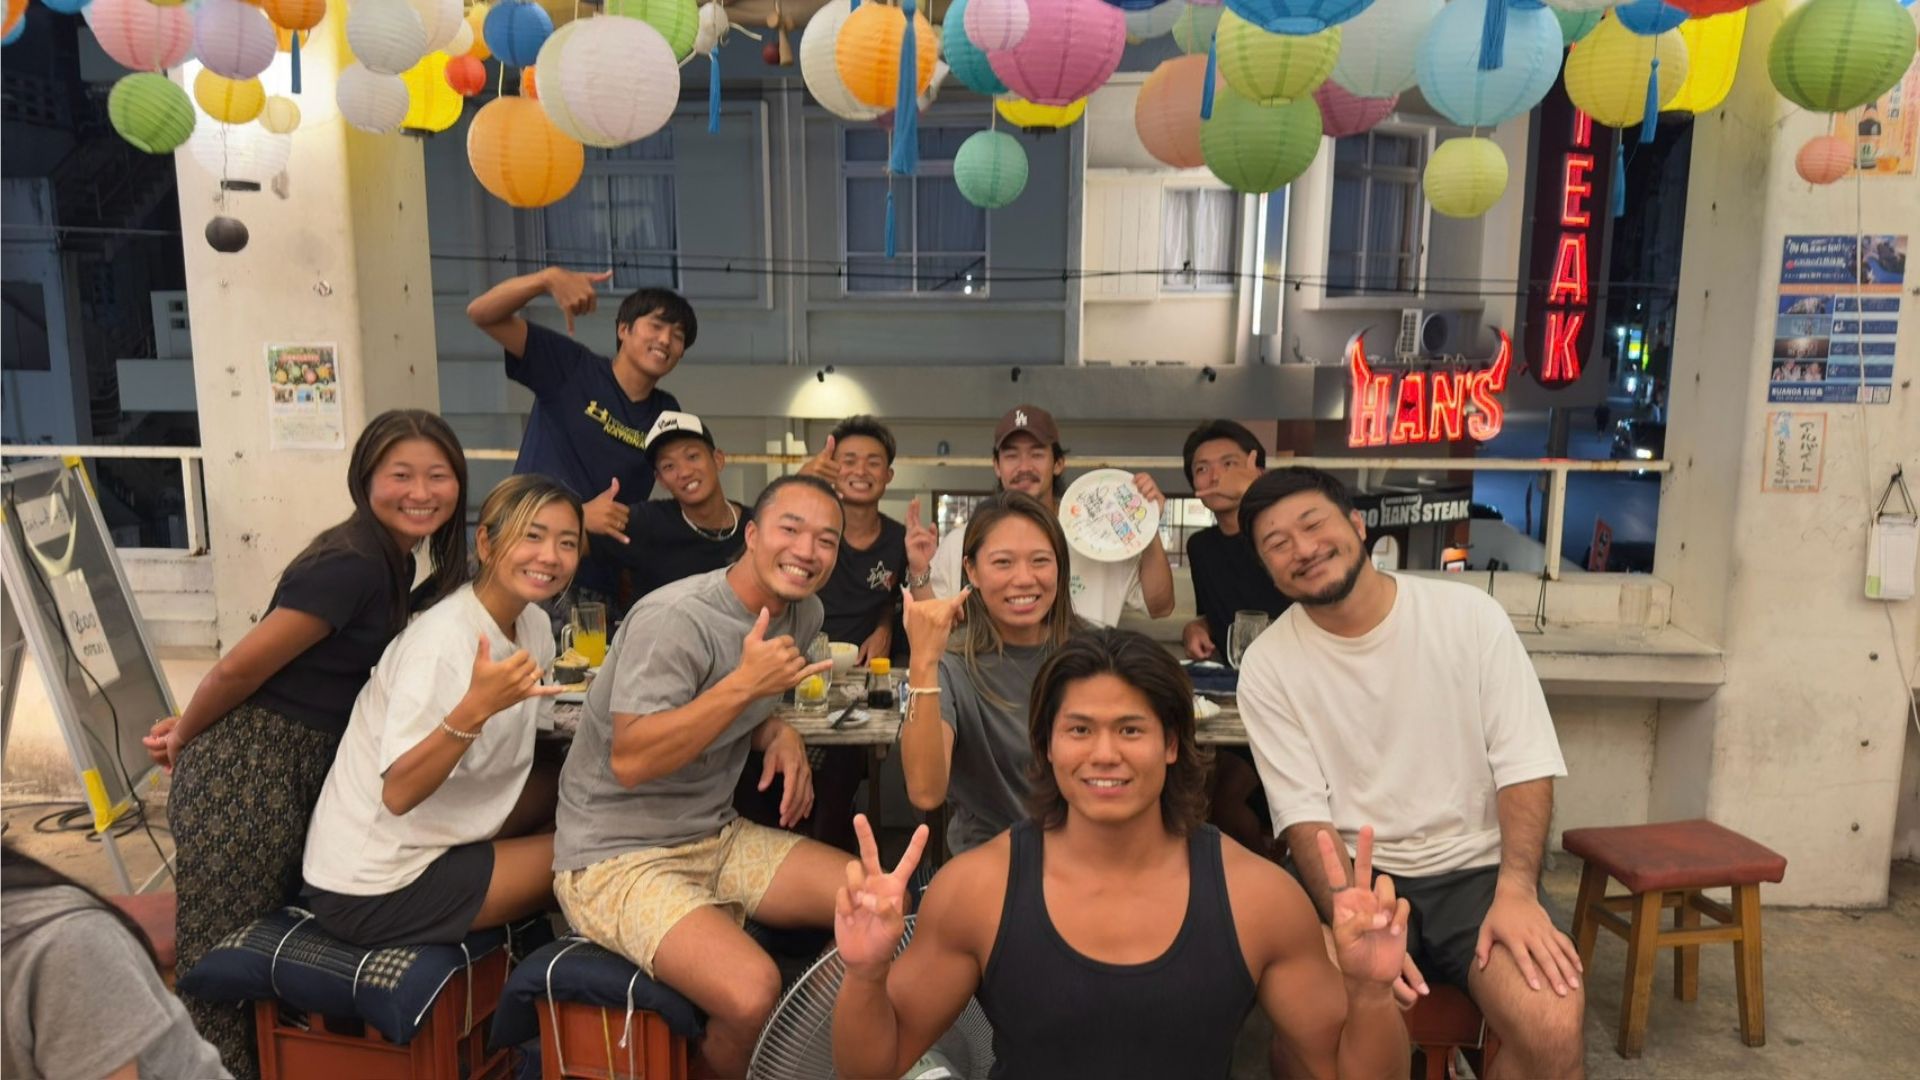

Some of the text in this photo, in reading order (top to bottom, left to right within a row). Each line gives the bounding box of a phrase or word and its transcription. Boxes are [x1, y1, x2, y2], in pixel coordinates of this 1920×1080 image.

[1348, 334, 1512, 448] HAN'S
[1015, 409, 1028, 427] LA
[1799, 421, 1818, 473] アルバイト
[1380, 495, 1422, 527] HAN'S
[1422, 500, 1470, 522] STEAK
